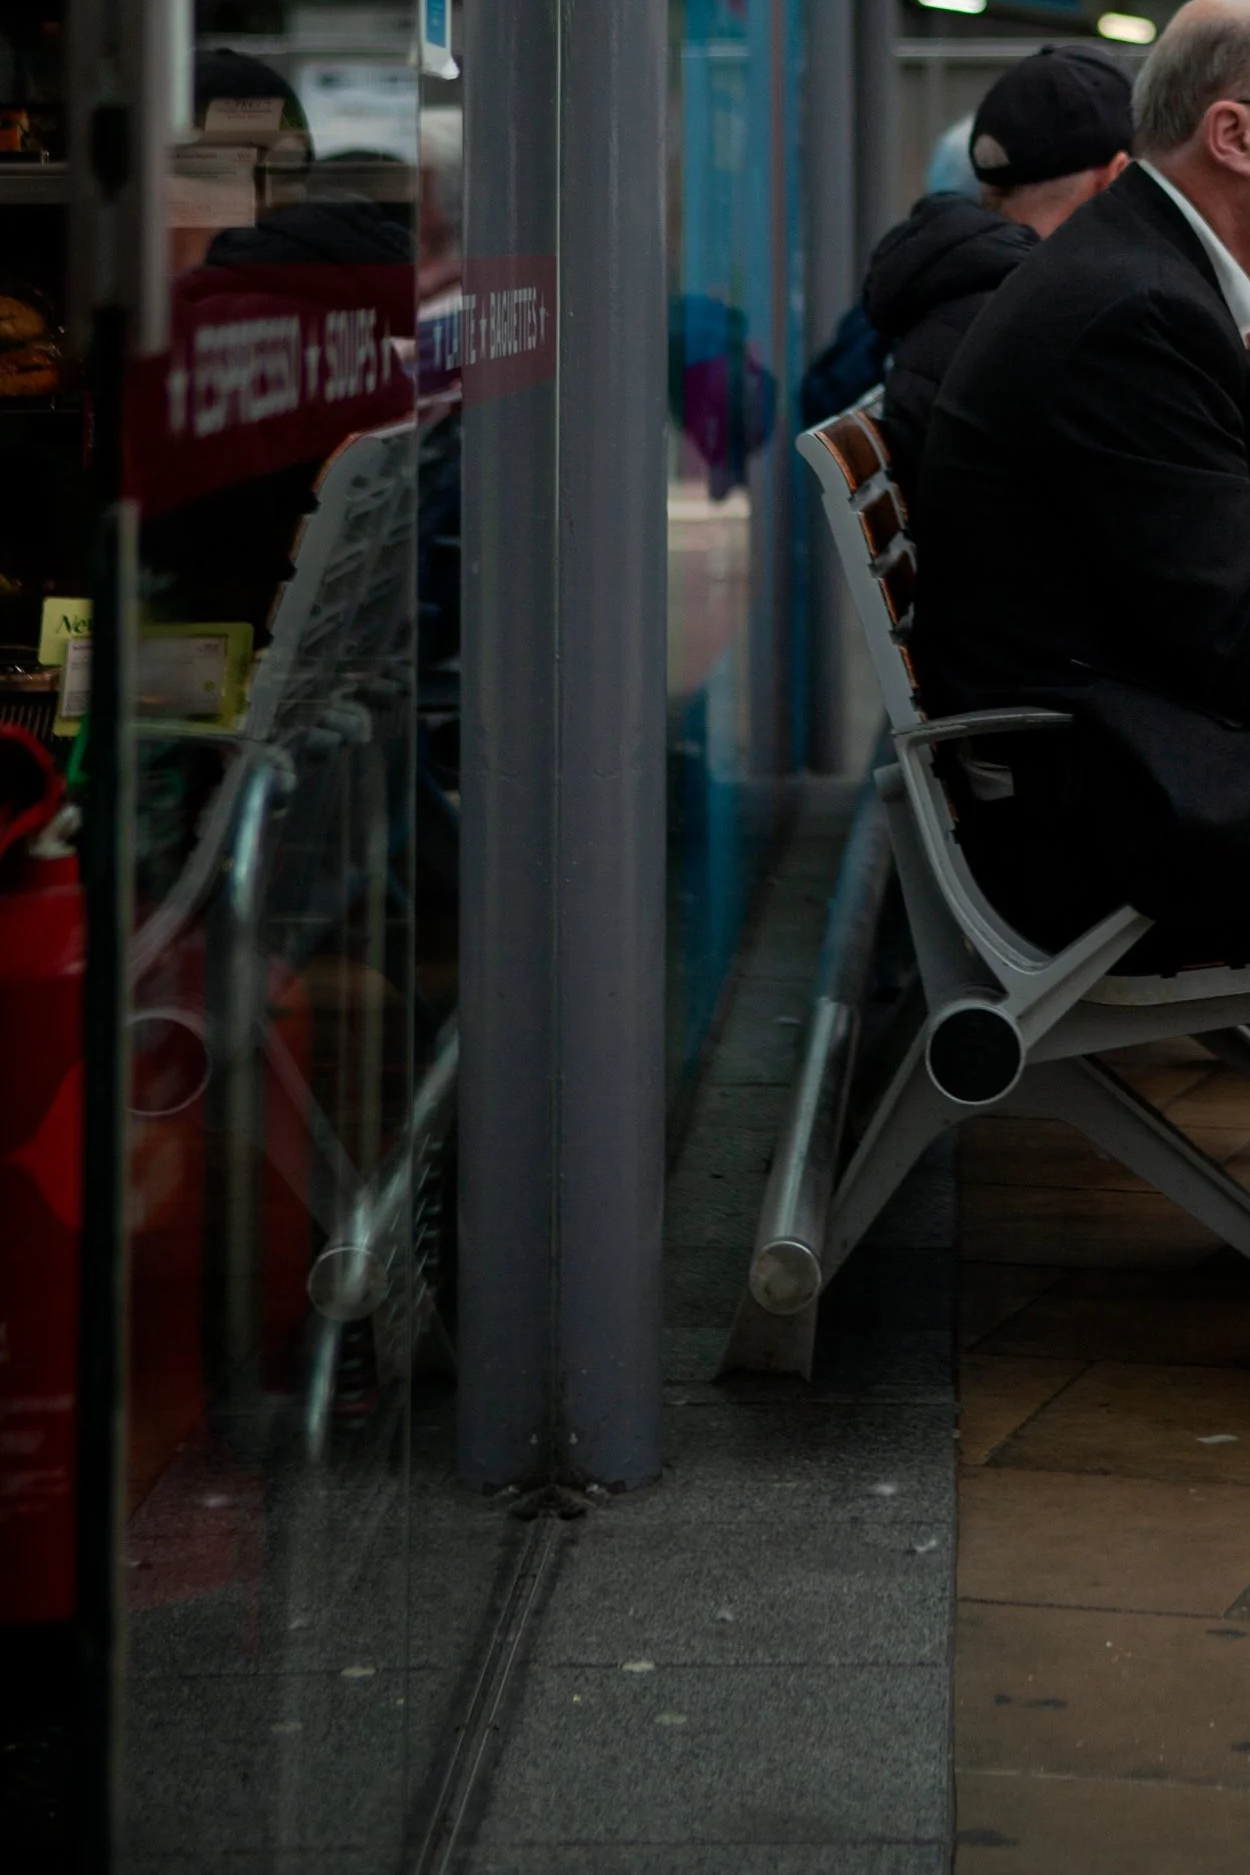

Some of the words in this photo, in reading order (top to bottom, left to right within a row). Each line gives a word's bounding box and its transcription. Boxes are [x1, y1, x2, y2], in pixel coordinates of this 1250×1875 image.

[324, 306, 378, 405] SOUPS
[444, 294, 476, 372] LATTE
[489, 285, 537, 361] BAGUETTES
